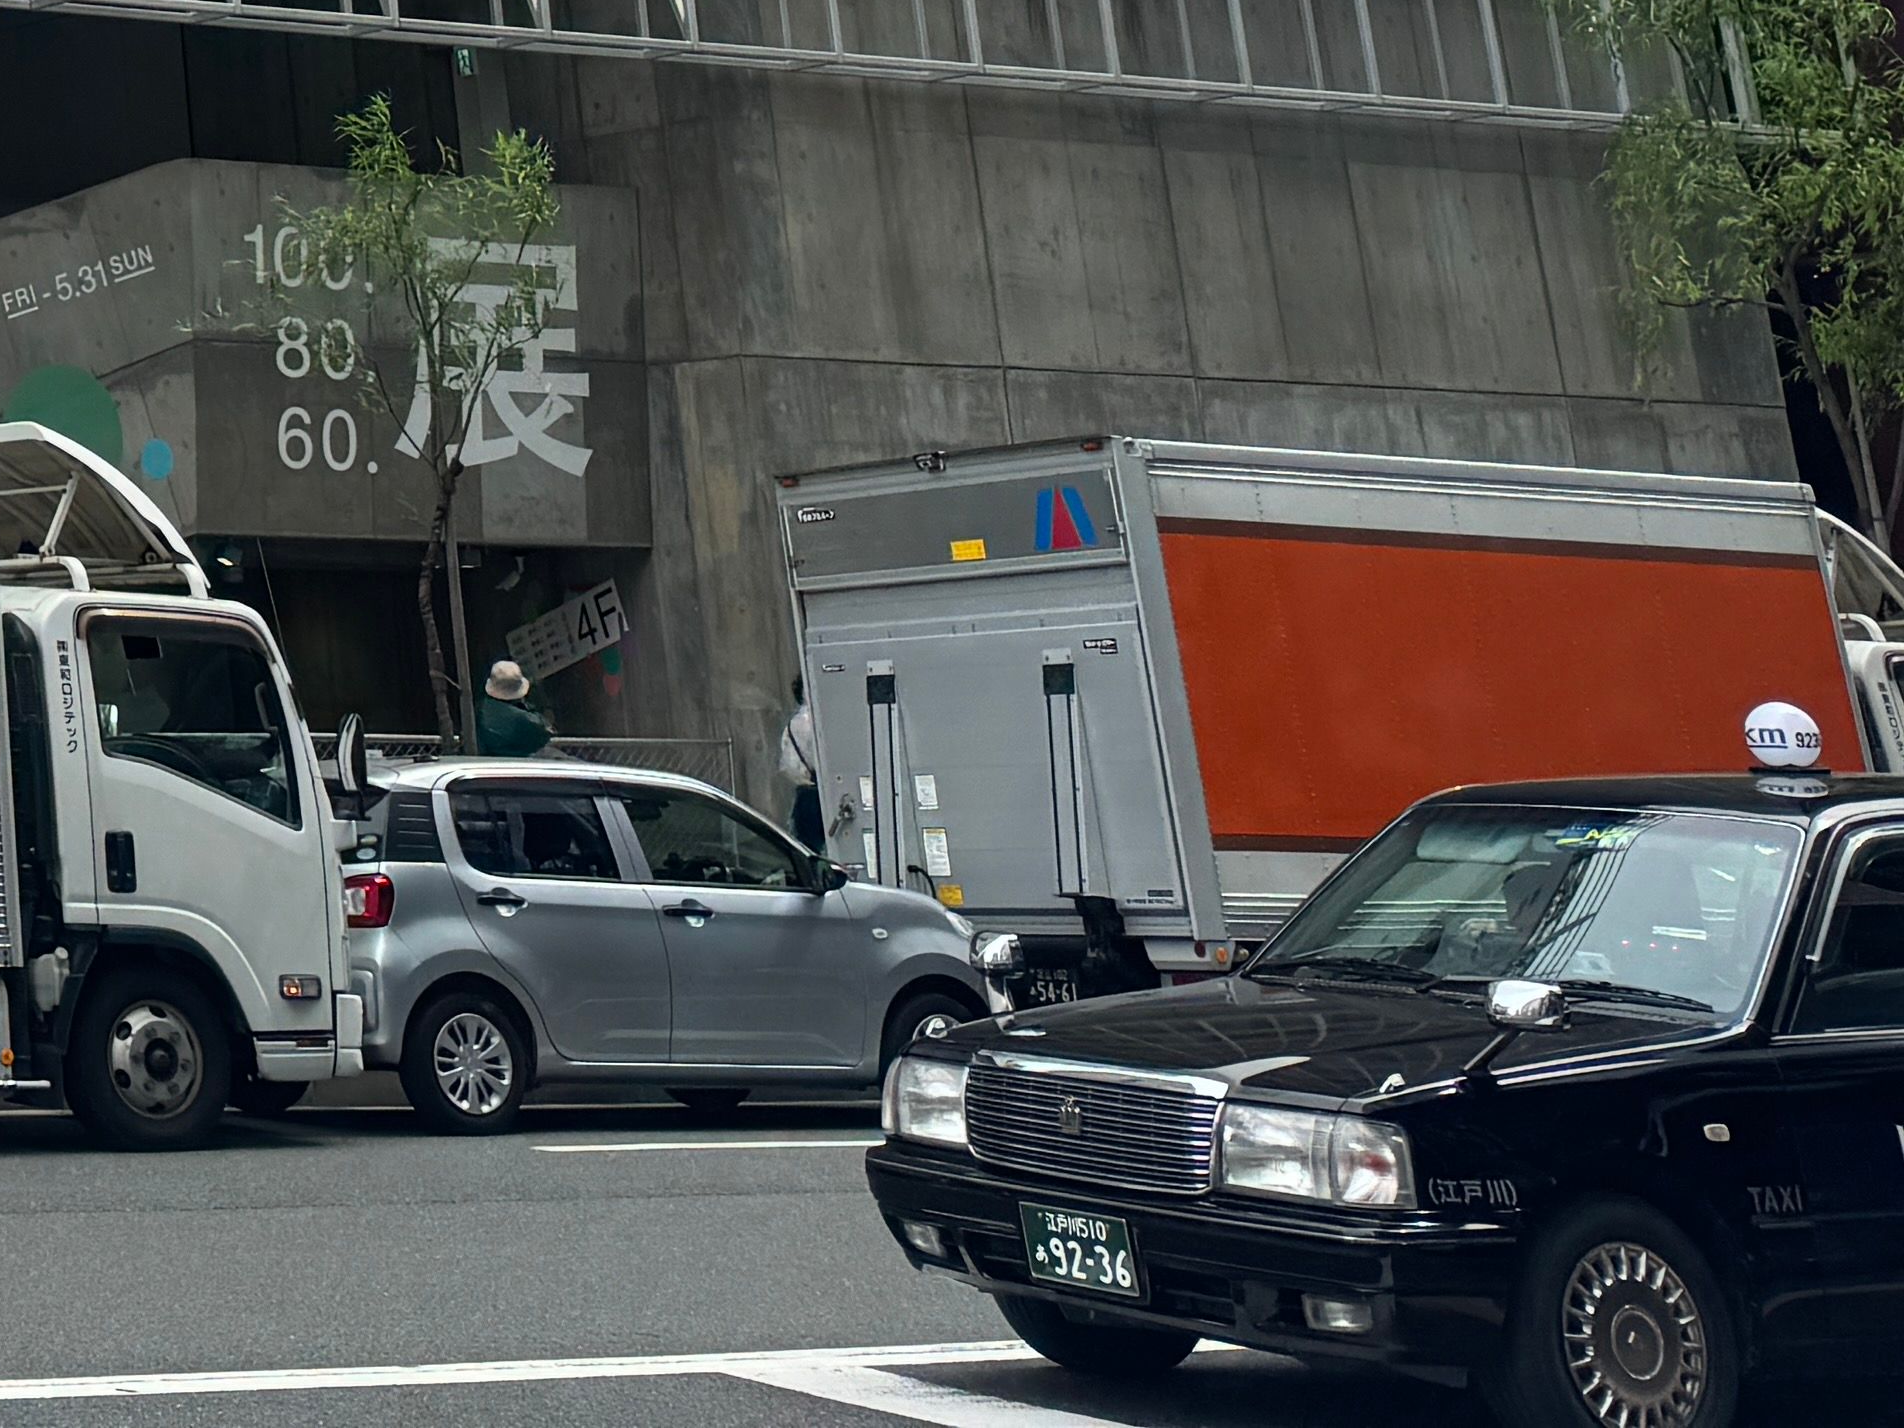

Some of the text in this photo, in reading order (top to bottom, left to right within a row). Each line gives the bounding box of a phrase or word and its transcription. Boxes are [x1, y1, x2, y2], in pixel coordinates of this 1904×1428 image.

[2, 283, 37, 313] FRI
[54, 259, 108, 302] 5.31
[109, 245, 154, 276] SUN
[394, 236, 594, 477] 展
[277, 406, 379, 475] 60.
[577, 587, 617, 646] 4F
[1427, 1177, 1518, 1207] (江戸川)
[1746, 1185, 1804, 1214] TAXI
[1035, 1237, 1132, 1288] あ 92-36
